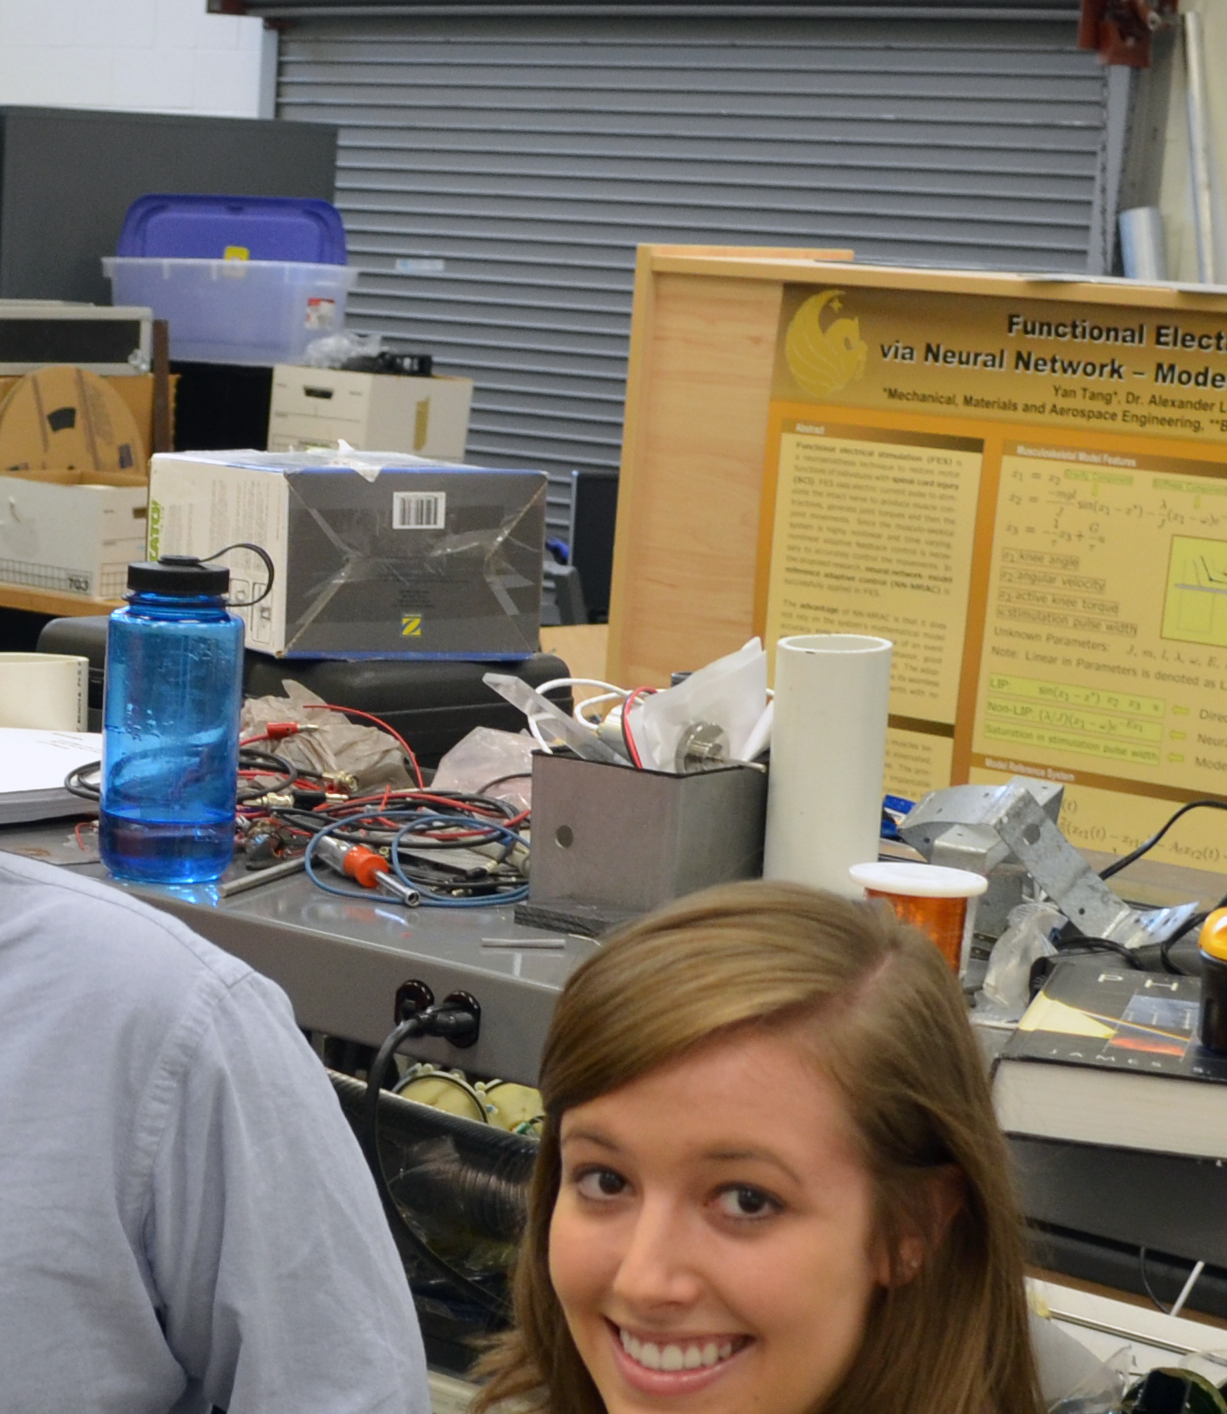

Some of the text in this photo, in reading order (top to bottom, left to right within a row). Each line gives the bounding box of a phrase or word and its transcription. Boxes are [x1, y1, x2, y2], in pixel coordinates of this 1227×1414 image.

[1007, 313, 1227, 352] Functional Elect
[880, 341, 915, 362] via
[925, 343, 1006, 370] Neural
[1015, 351, 1125, 380] Network
[1155, 362, 1227, 389] Mode
[963, 395, 1018, 412] Materials
[1022, 401, 1045, 414] and
[1049, 403, 1118, 422] Aerospace
[1053, 384, 1077, 400] Yan
[1126, 391, 1145, 406] Dr.
[1149, 394, 1216, 412] Alexander
[994, 626, 1043, 642] Unknown
[1076, 657, 1138, 678] Parameters
